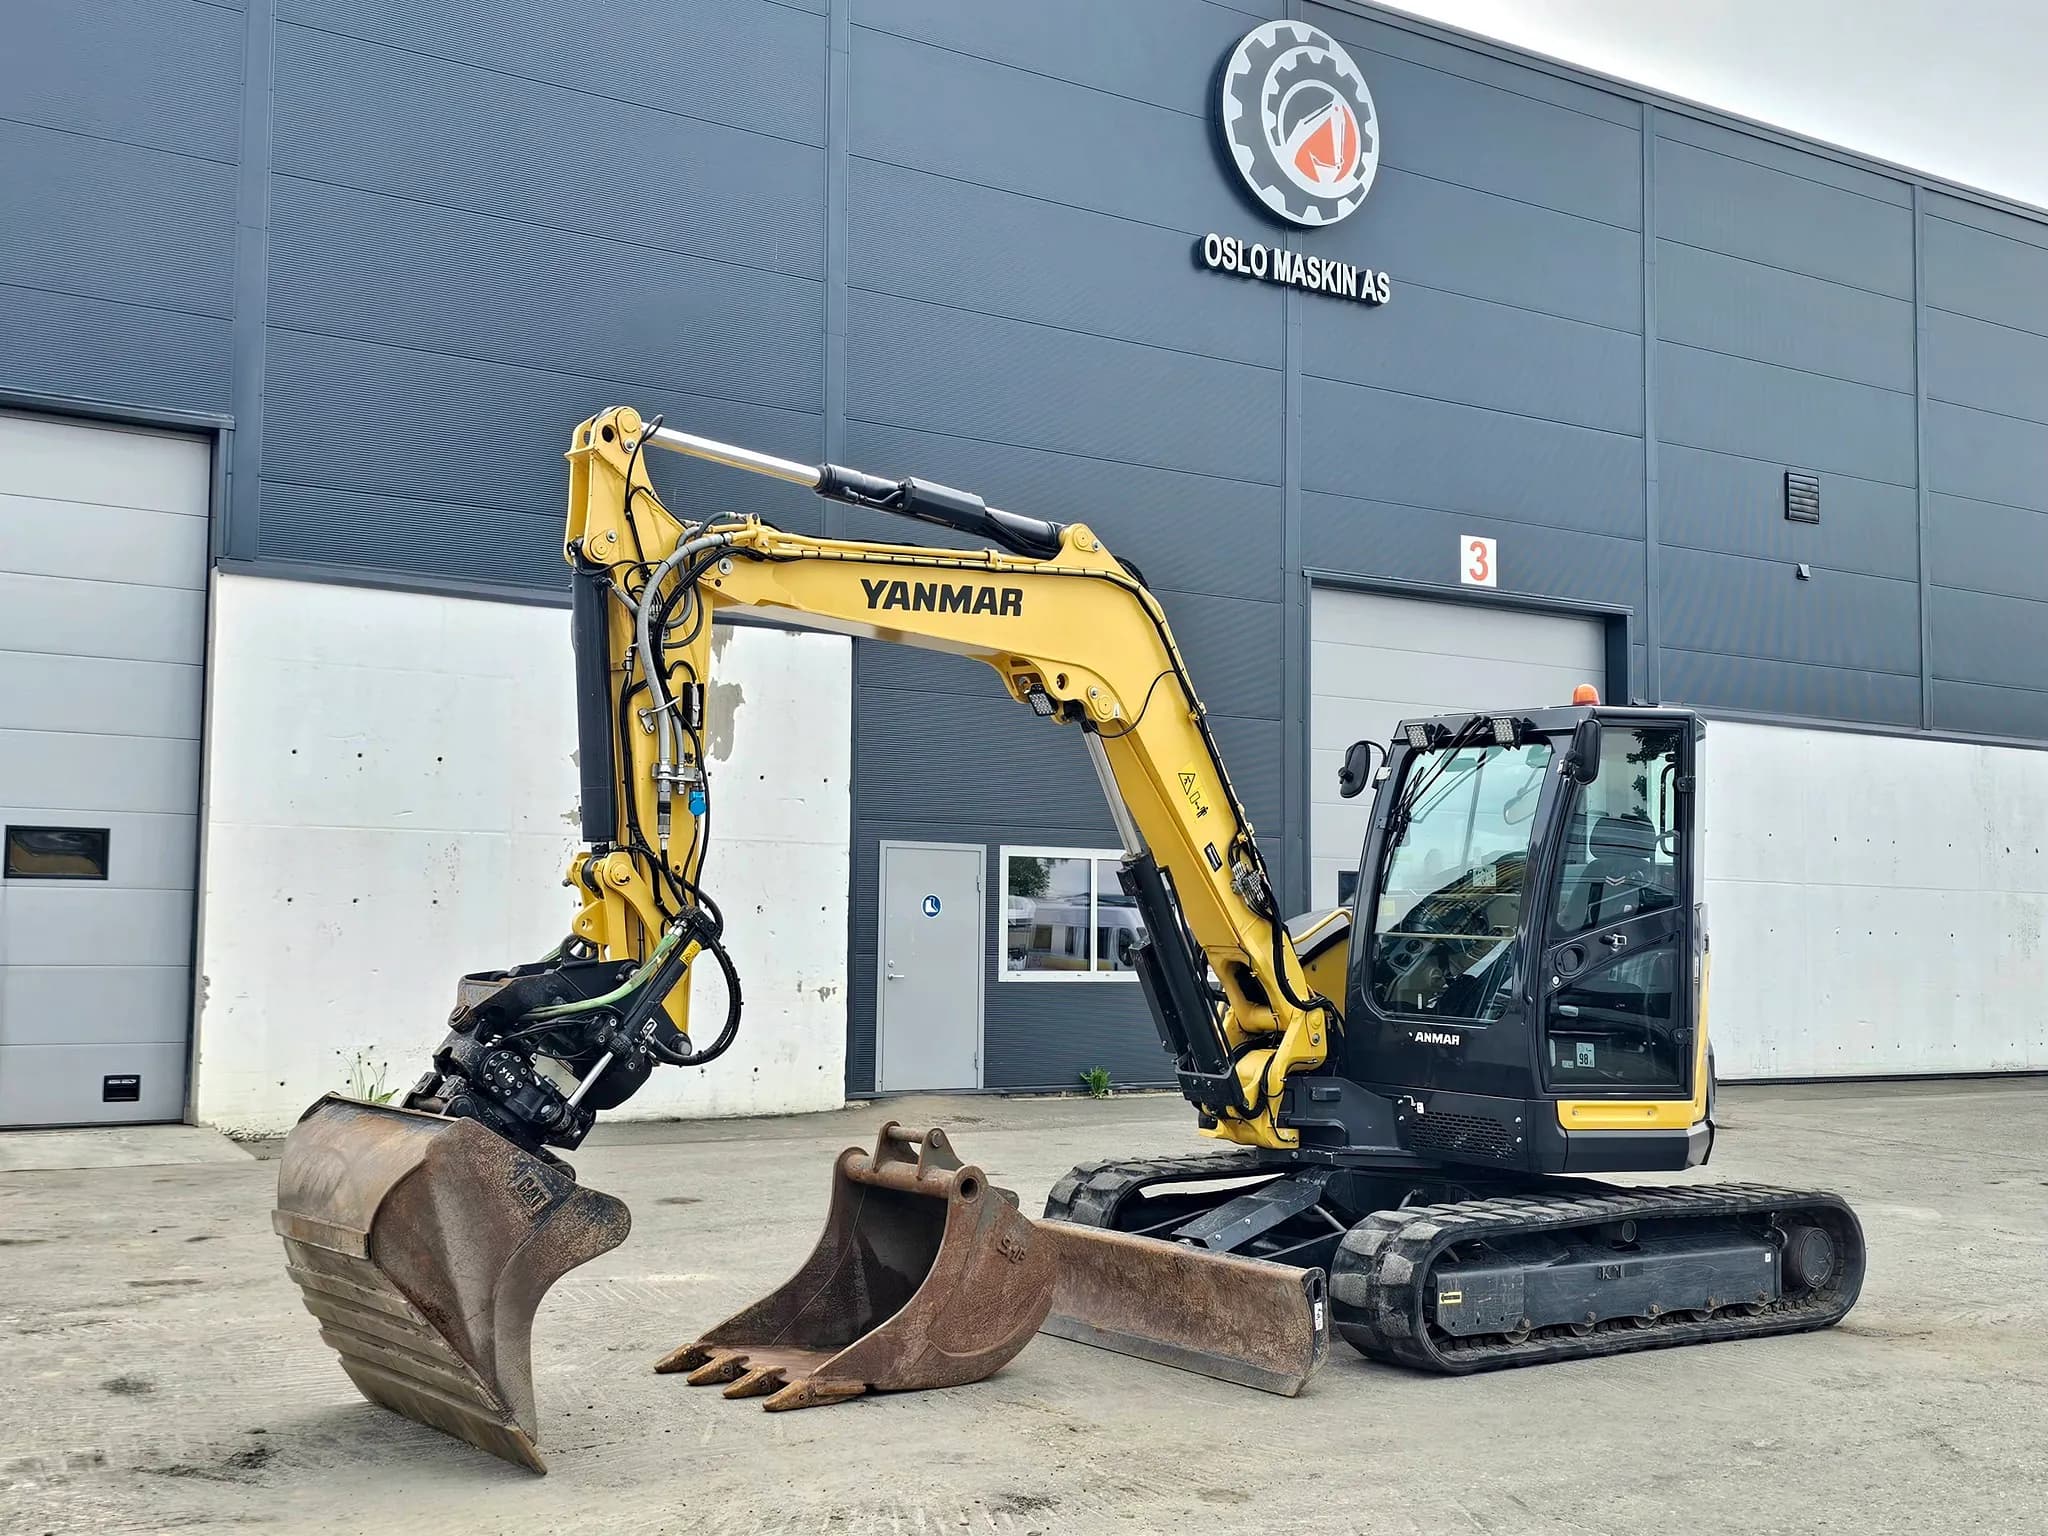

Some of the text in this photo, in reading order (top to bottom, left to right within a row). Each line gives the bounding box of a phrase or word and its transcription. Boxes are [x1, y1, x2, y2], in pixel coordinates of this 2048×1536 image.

[1204, 232, 1391, 304] OSLO MASKIN AS
[1469, 540, 1489, 581] 3
[860, 578, 1024, 617] YANMAR
[1408, 1031, 1460, 1046] ANMAR
[516, 1177, 547, 1209] CAT
